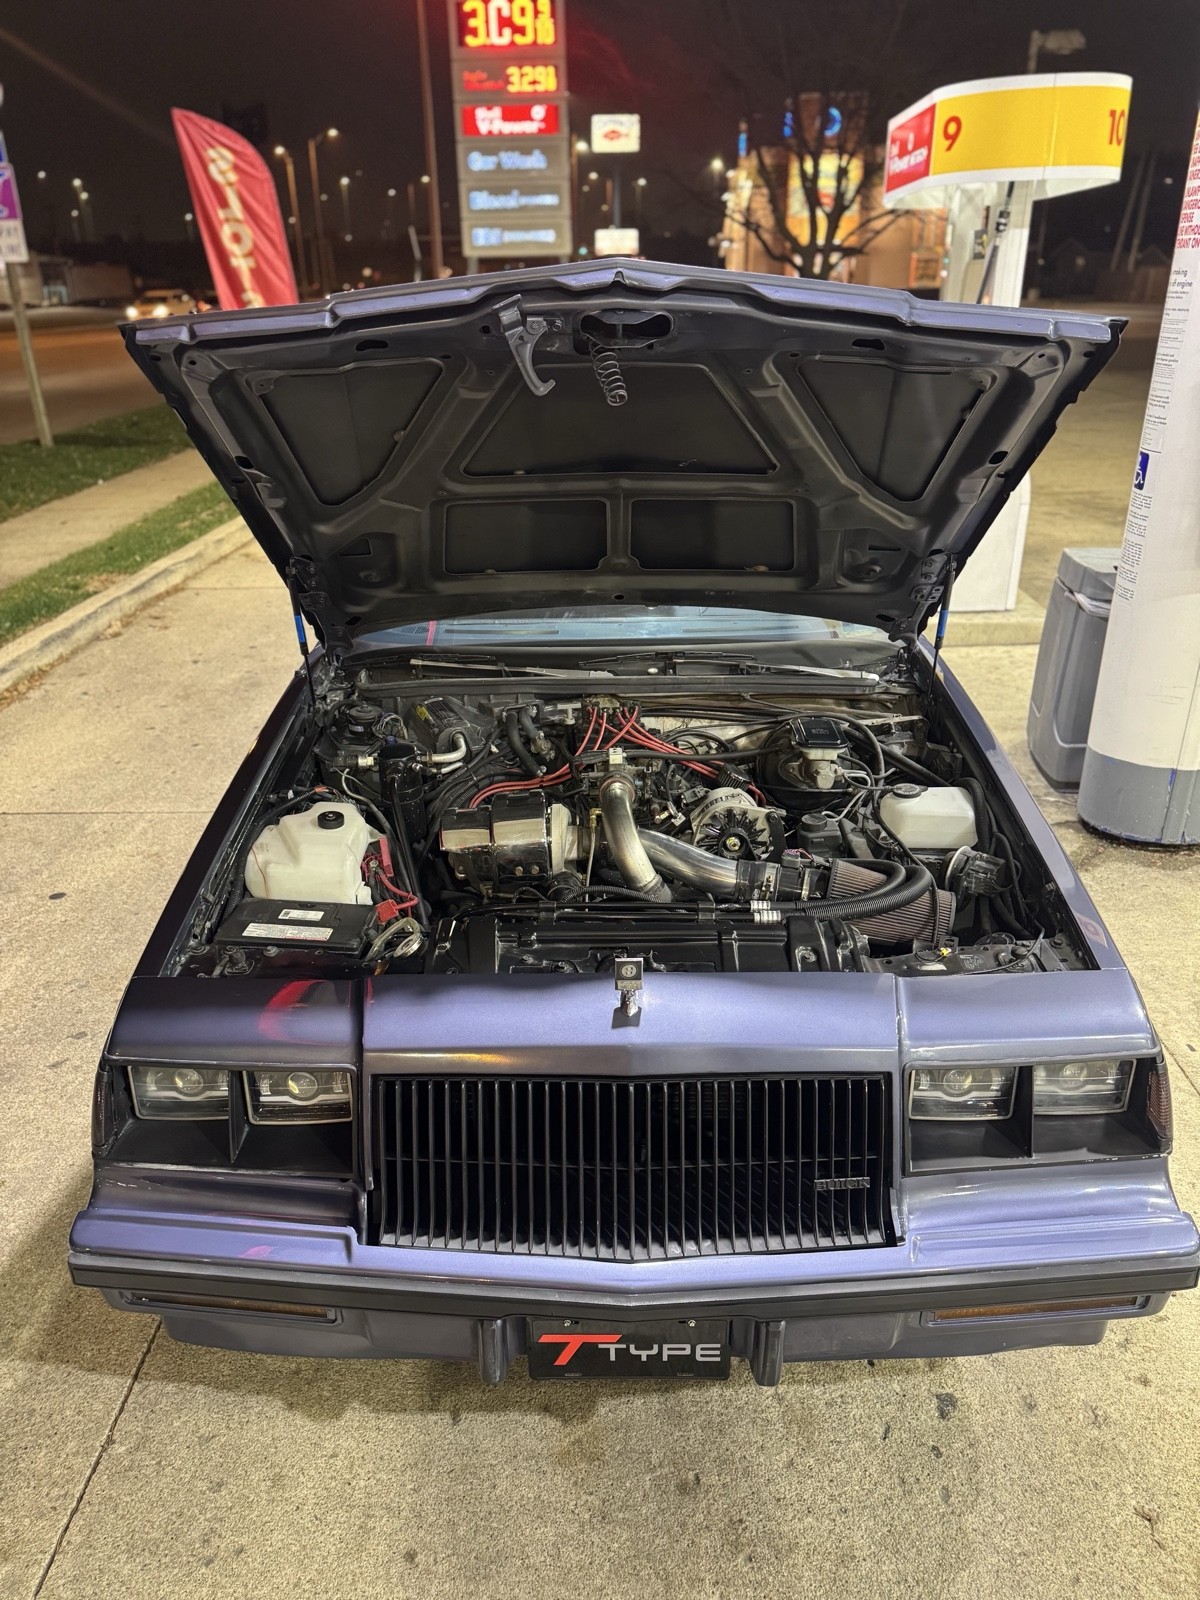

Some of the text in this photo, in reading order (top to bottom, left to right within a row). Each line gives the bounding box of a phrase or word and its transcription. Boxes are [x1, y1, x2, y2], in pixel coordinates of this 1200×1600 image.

[943, 115, 962, 152] 9
[1108, 109, 1126, 146] 10
[1177, 279, 1193, 290] engine
[813, 1176, 871, 1191] BUICK
[598, 1343, 721, 1362] TYPE
